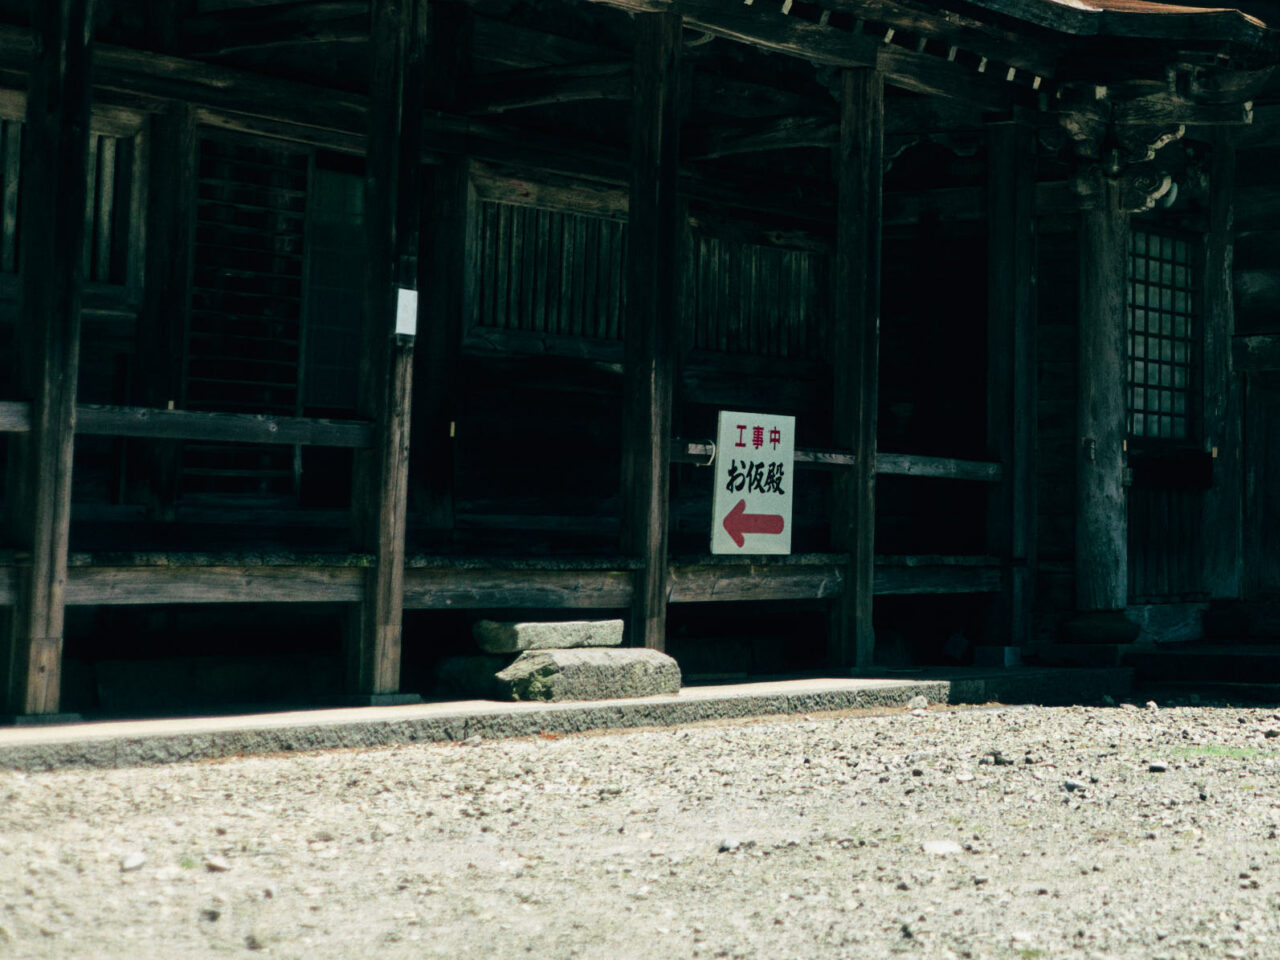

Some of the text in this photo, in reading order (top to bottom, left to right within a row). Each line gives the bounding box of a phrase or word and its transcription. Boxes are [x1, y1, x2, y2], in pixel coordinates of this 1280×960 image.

[735, 425, 781, 451] 工事中
[726, 459, 785, 495] お仮殿
